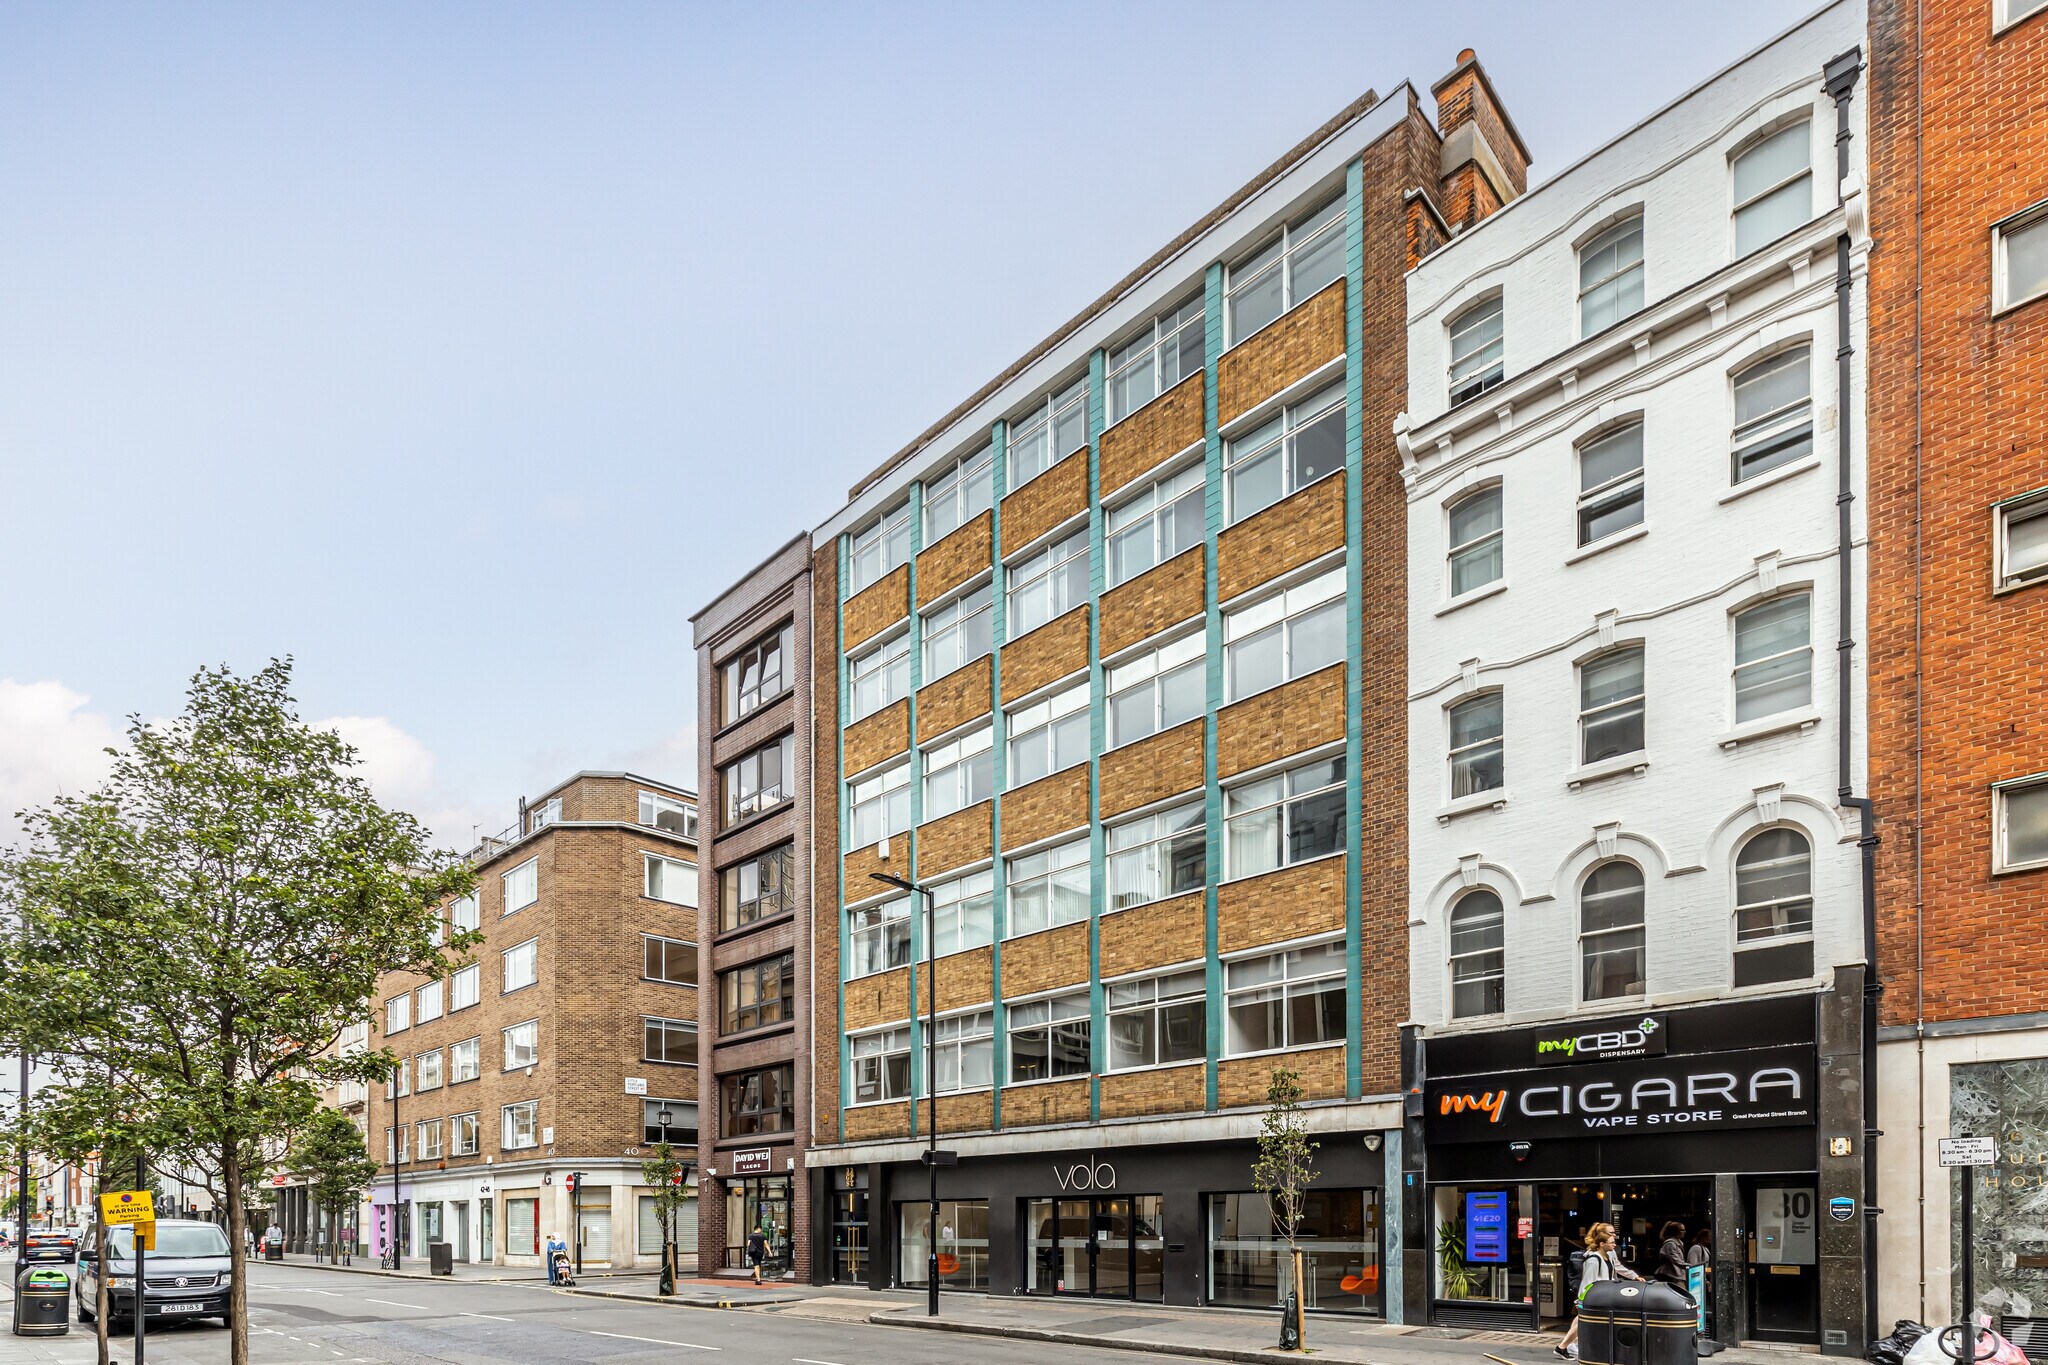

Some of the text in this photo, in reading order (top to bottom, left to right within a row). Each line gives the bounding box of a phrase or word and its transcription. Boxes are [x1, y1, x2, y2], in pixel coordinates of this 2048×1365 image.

[1600, 1048, 1646, 1058] DISPENSARY
[1440, 1067, 1801, 1123] my CIGARA
[1583, 1110, 1722, 1128] VAPE STORE
[547, 1147, 555, 1156] 40
[624, 1147, 639, 1155] 40
[735, 1152, 769, 1163] DAVID WEJ
[1053, 1154, 1116, 1190] vola
[107, 1205, 150, 1215] WARNING
[1772, 1192, 1811, 1219] 30
